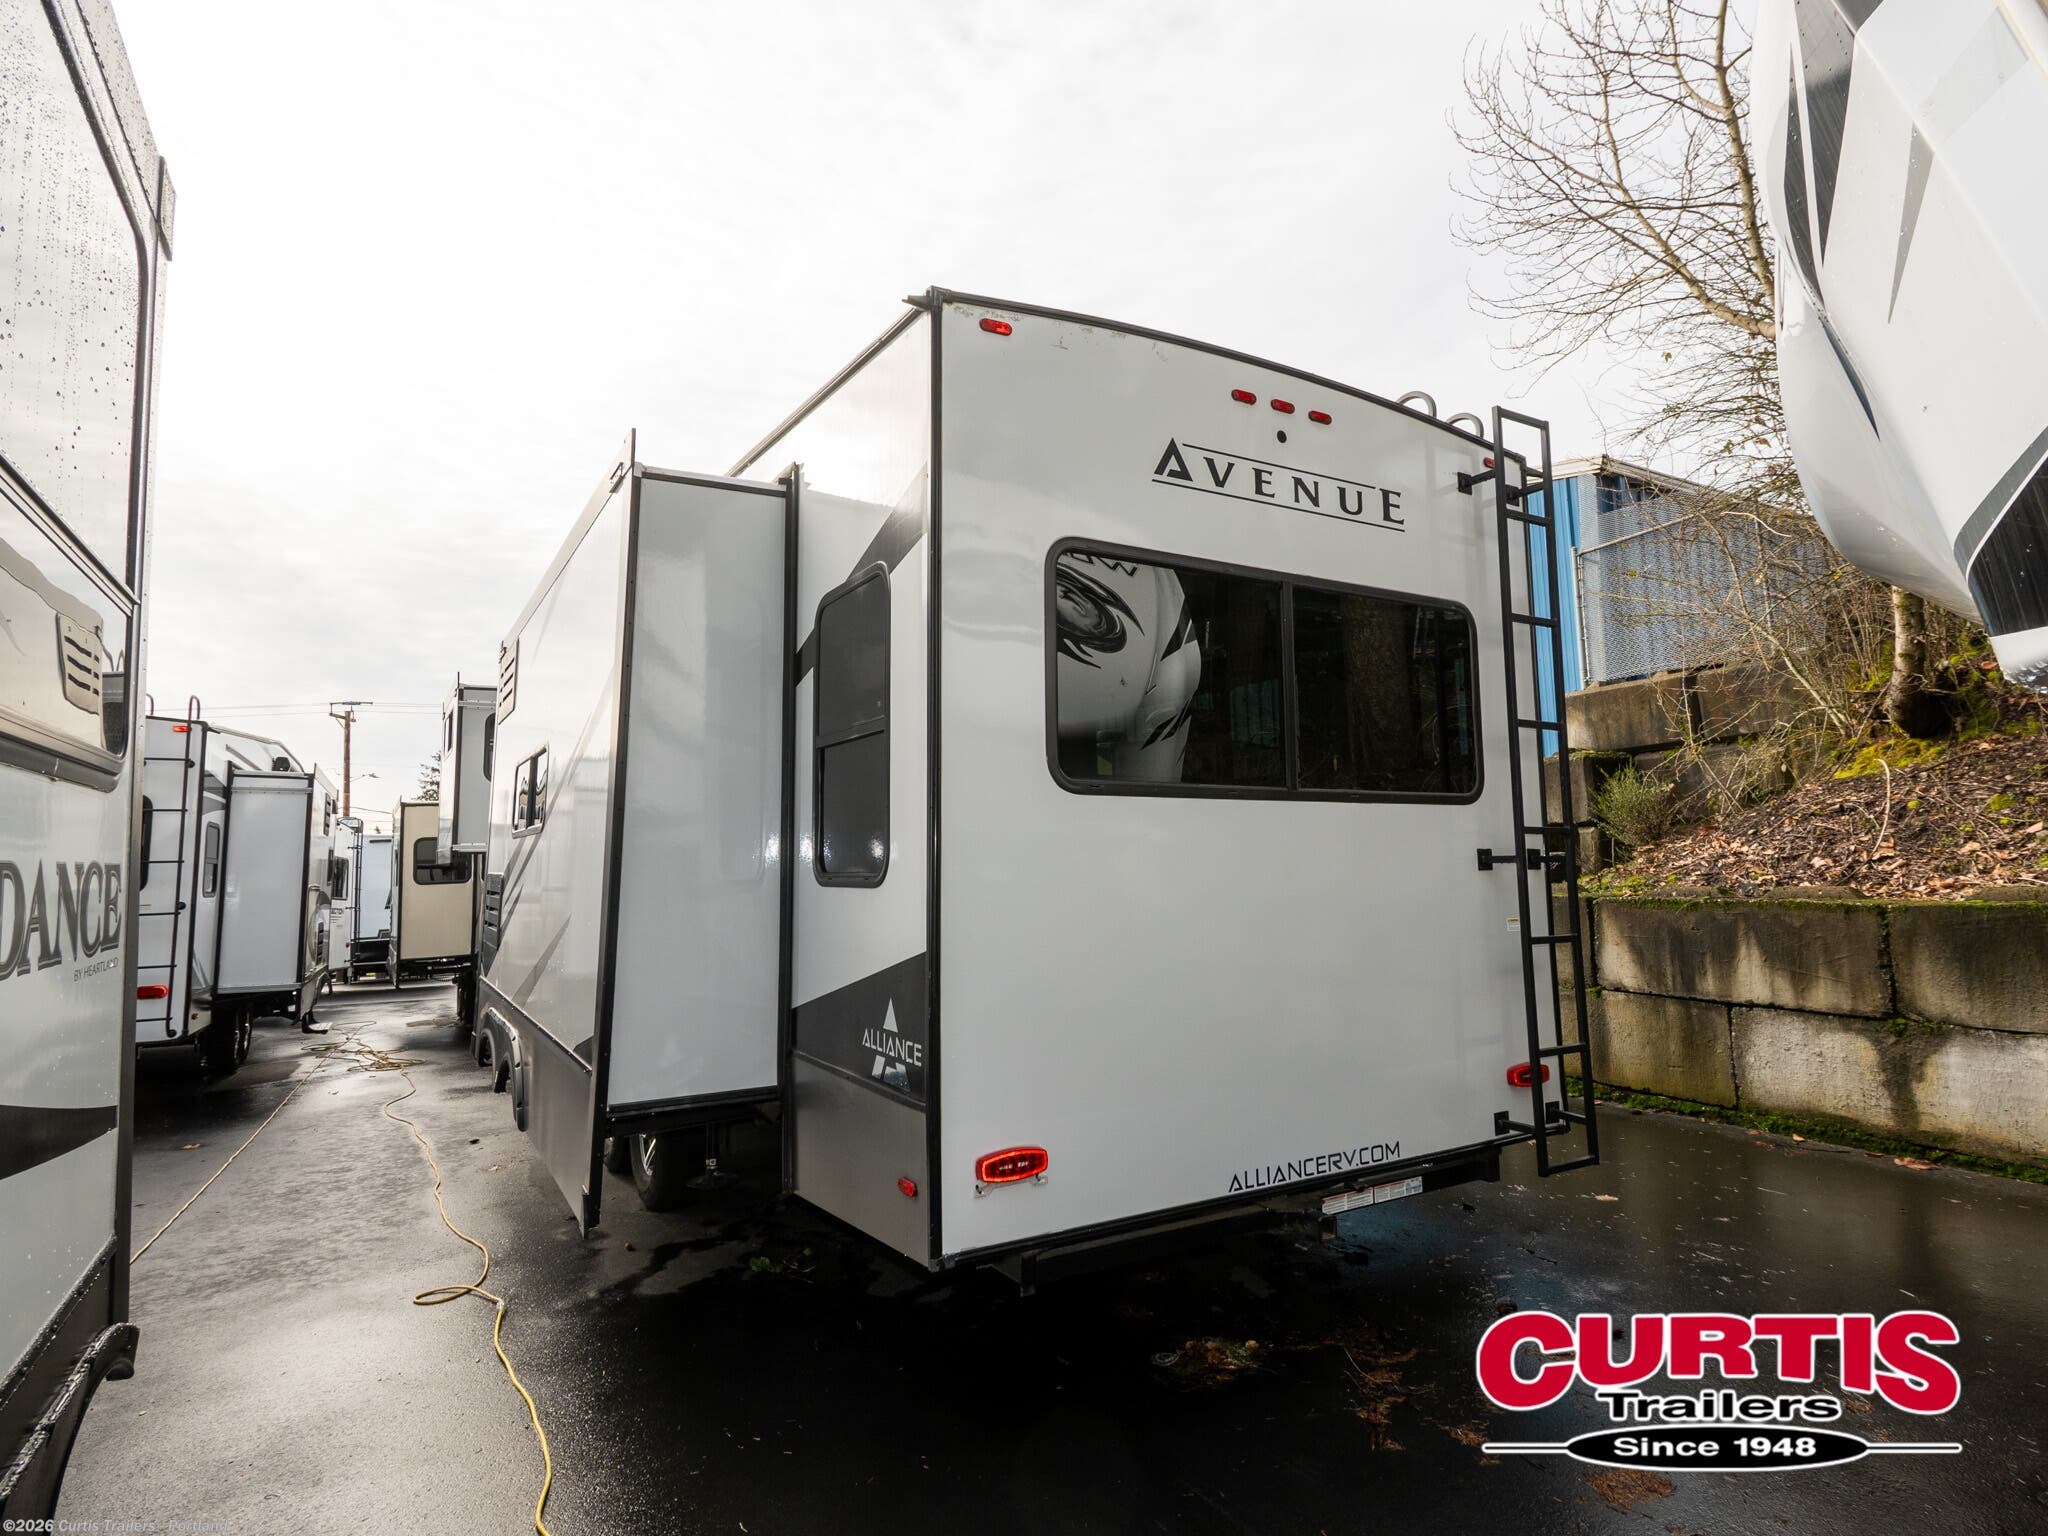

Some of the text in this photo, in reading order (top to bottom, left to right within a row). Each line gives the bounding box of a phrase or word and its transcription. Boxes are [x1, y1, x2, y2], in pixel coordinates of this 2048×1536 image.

[1154, 437, 1405, 525] AVENUE
[73, 969, 82, 982] BY
[862, 1027, 922, 1067] ALLIANCE
[1229, 1141, 1401, 1193] ALLIANCERV.COM
